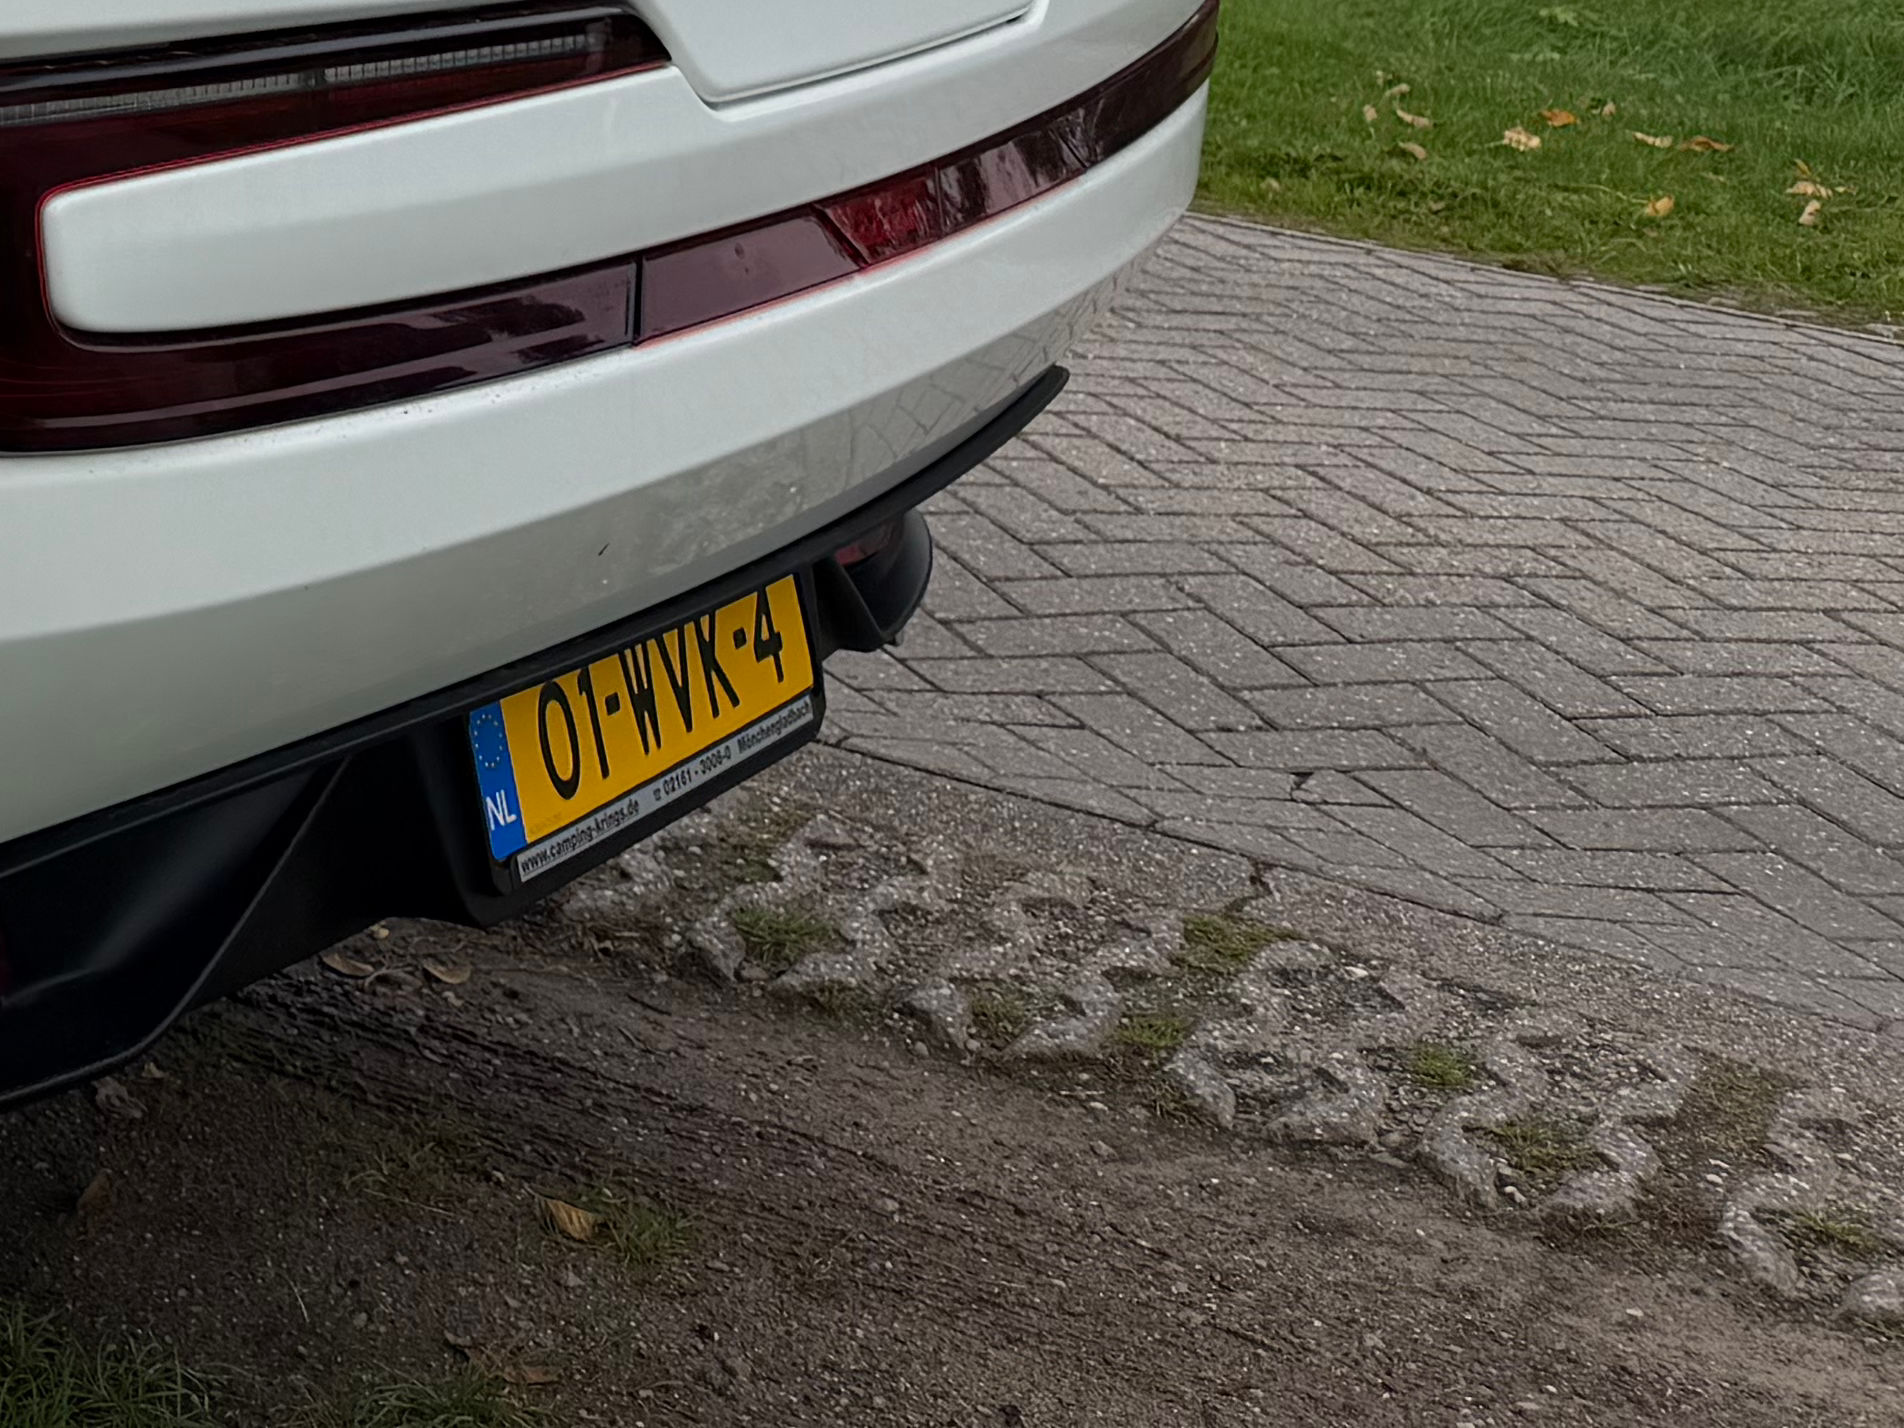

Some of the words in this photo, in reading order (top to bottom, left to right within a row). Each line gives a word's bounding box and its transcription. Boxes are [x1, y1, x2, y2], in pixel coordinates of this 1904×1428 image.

[537, 587, 784, 801] 01-WVK-4
[484, 789, 518, 831] NL
[519, 798, 640, 874] www.camping-krings.de
